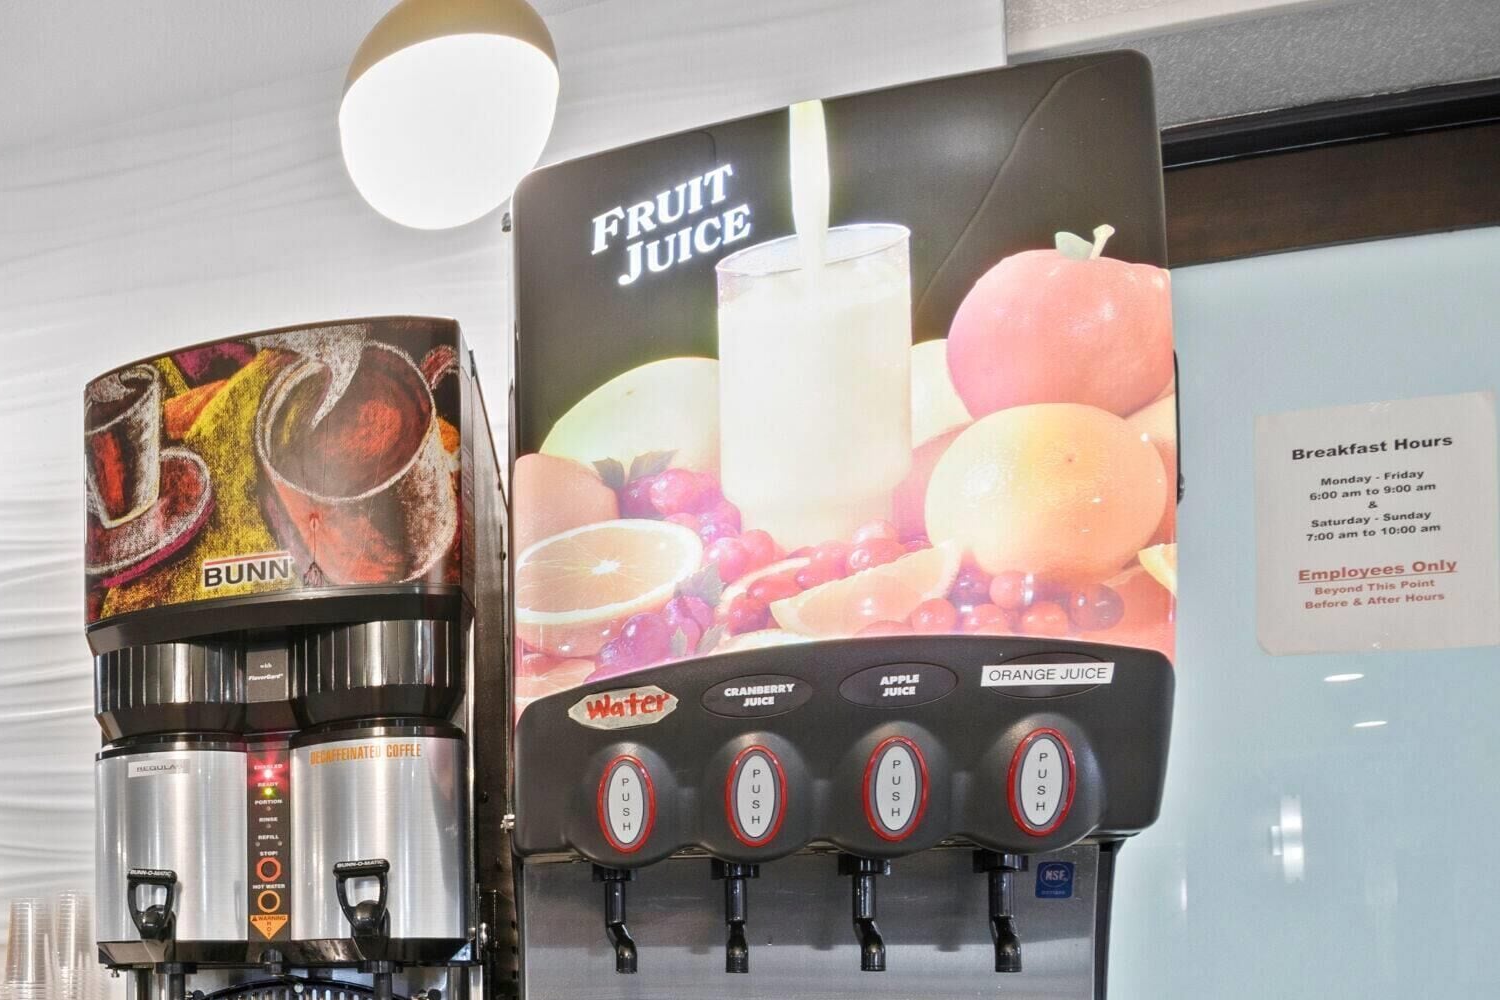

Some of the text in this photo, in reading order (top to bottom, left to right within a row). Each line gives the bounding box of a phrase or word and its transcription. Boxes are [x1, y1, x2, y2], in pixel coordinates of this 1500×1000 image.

[591, 163, 734, 255] FRUIT
[617, 204, 752, 286] JUICE
[1292, 435, 1453, 460] Breakfast Hours
[1320, 474, 1372, 486] Monday
[1384, 470, 1424, 482] Friday
[1310, 482, 1436, 501] 6:00 am to 9:00 am
[1368, 500, 1378, 510] &
[1310, 515, 1372, 528] Saturday
[1383, 510, 1432, 522] Sunday
[1306, 523, 1441, 542] 7:00 am to 10:00 am
[204, 559, 288, 588] BUNN
[1298, 558, 1458, 582] Employees Only
[1314, 578, 1436, 596] Beyond This Point
[1304, 592, 1444, 610] Before & After Hours
[880, 674, 920, 686] APPLE
[989, 666, 1108, 682] ORANGE JUICE
[724, 684, 795, 696] CRANBERRY
[882, 686, 916, 697] JUICE
[586, 692, 670, 720] Water
[742, 696, 775, 707] JUICE
[310, 743, 422, 765] DECAFFEINATED COFFEE
[890, 759, 901, 817] PUSH
[1036, 752, 1048, 811] PUSH
[621, 777, 631, 832] PUSH
[752, 769, 761, 825] PUSH
[1045, 870, 1066, 880] NSF
